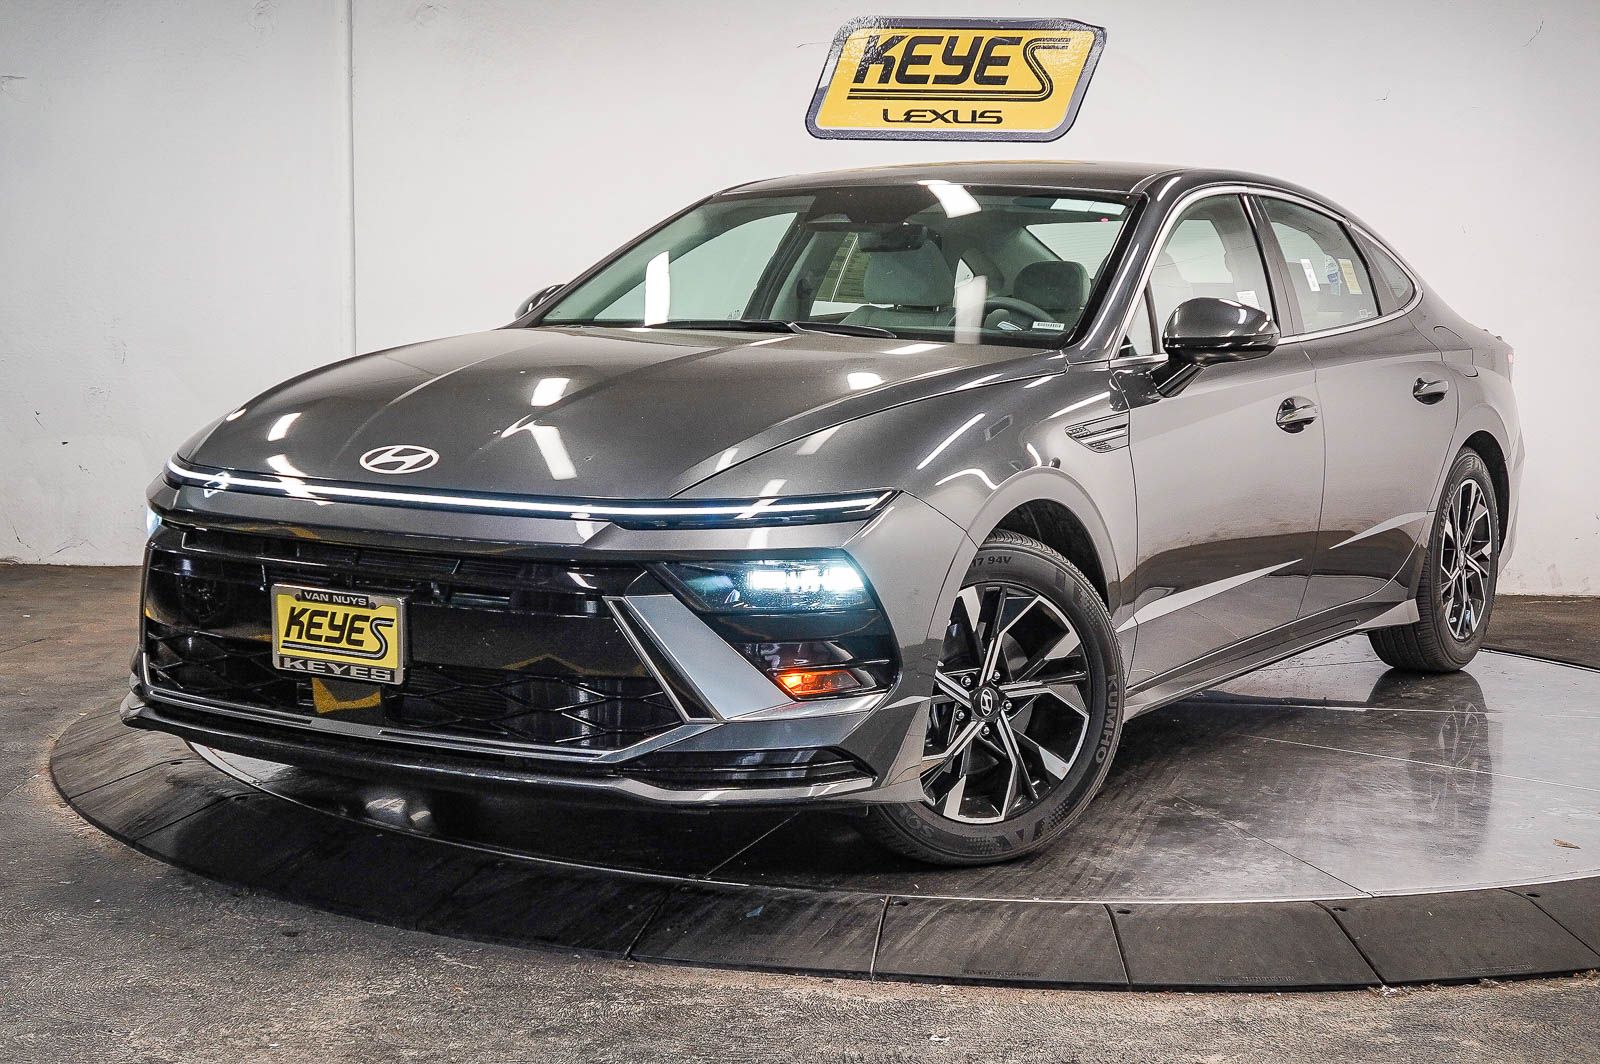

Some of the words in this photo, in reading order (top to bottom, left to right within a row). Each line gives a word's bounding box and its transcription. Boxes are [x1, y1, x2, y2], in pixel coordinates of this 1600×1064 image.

[847, 35, 1071, 102] KEYES
[882, 108, 1004, 125] LEXUS
[304, 591, 329, 602] VAN
[332, 595, 367, 606] NUYS
[281, 606, 395, 660] KEYES
[283, 657, 391, 681] KEYES
[1095, 674, 1118, 763] KUMHO
